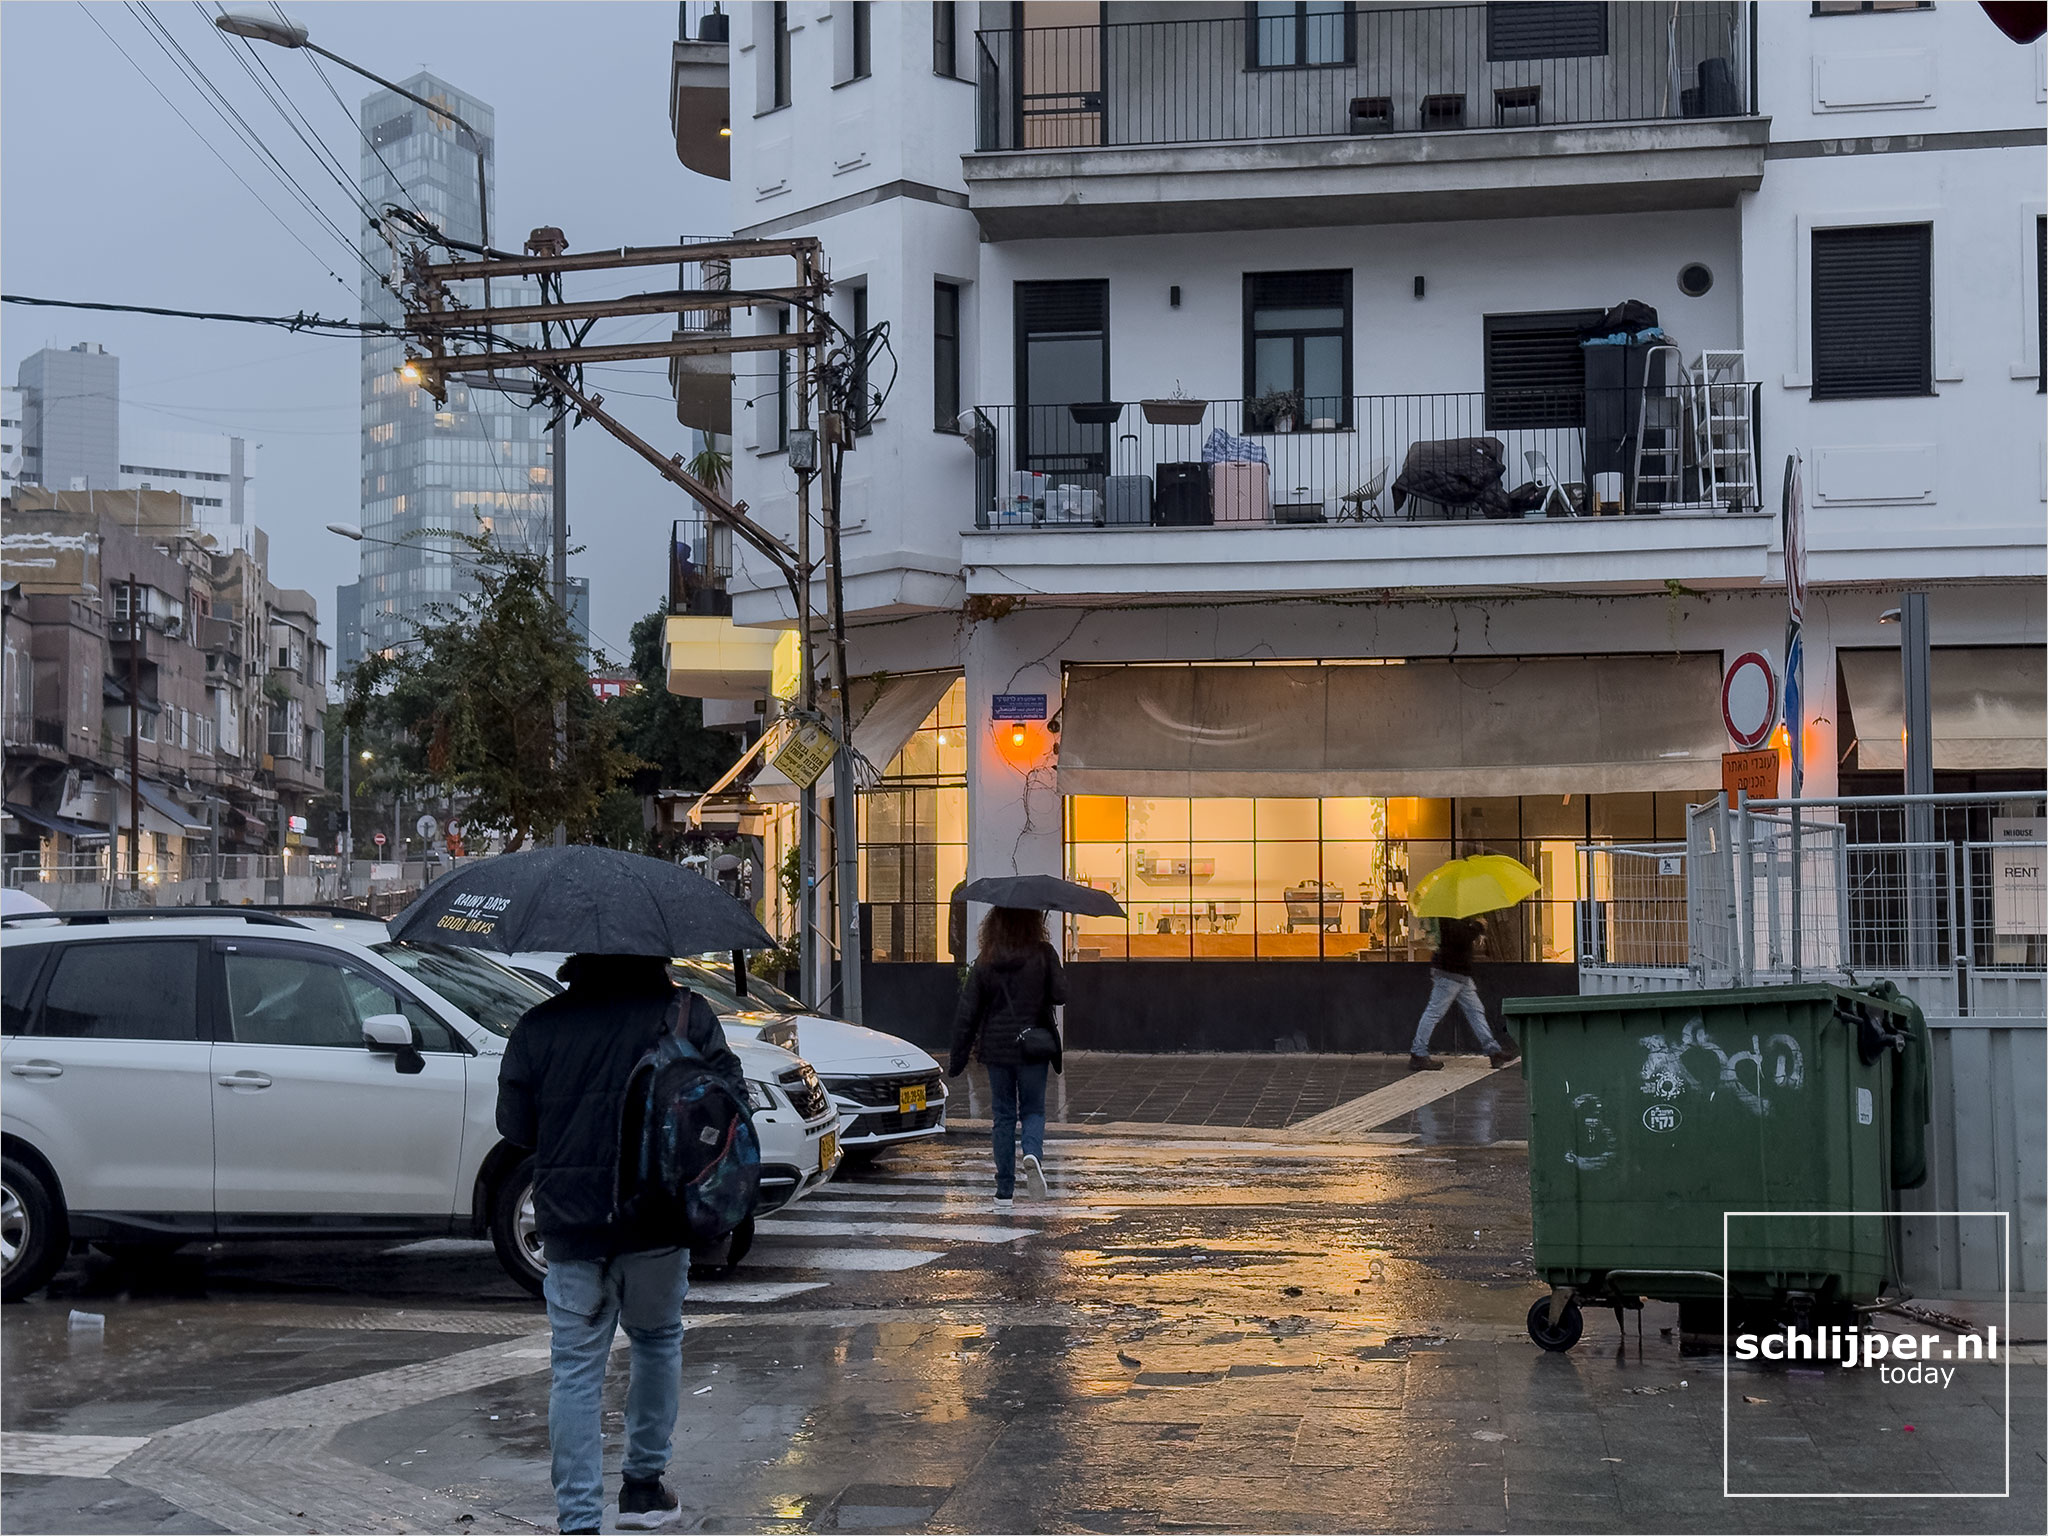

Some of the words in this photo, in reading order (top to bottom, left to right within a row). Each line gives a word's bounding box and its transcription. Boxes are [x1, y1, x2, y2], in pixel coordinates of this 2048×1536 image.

[1726, 760, 1748, 773] האתר
[1751, 753, 1777, 770] לעובדי
[1737, 776, 1766, 789] הכניסה
[2004, 867, 2040, 878] RENT
[453, 893, 487, 909] RAINY
[482, 896, 511, 912] DAYS
[436, 915, 468, 931] GOOD
[465, 919, 495, 934] DAYS
